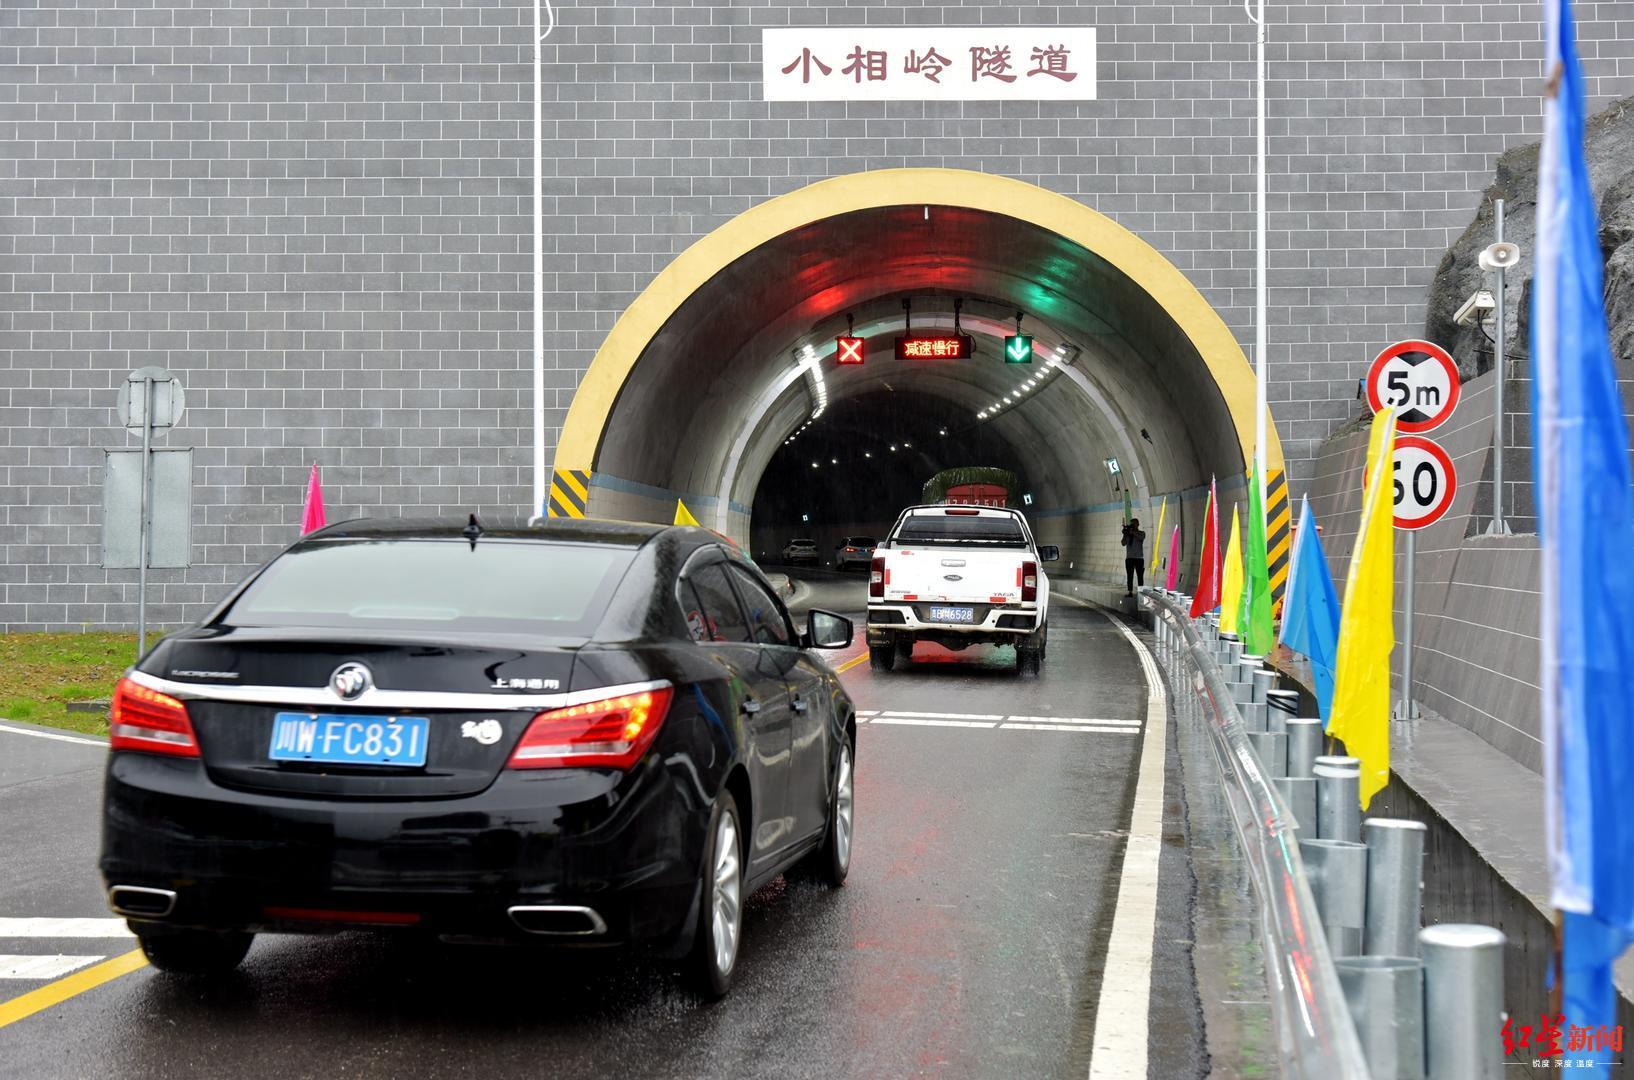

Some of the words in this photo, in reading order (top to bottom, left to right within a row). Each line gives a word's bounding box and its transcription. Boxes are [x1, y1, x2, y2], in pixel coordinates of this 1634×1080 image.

[781, 44, 1078, 83] 小相岭隧道
[904, 340, 960, 356] 减速慢行
[1387, 371, 1440, 407] 5m
